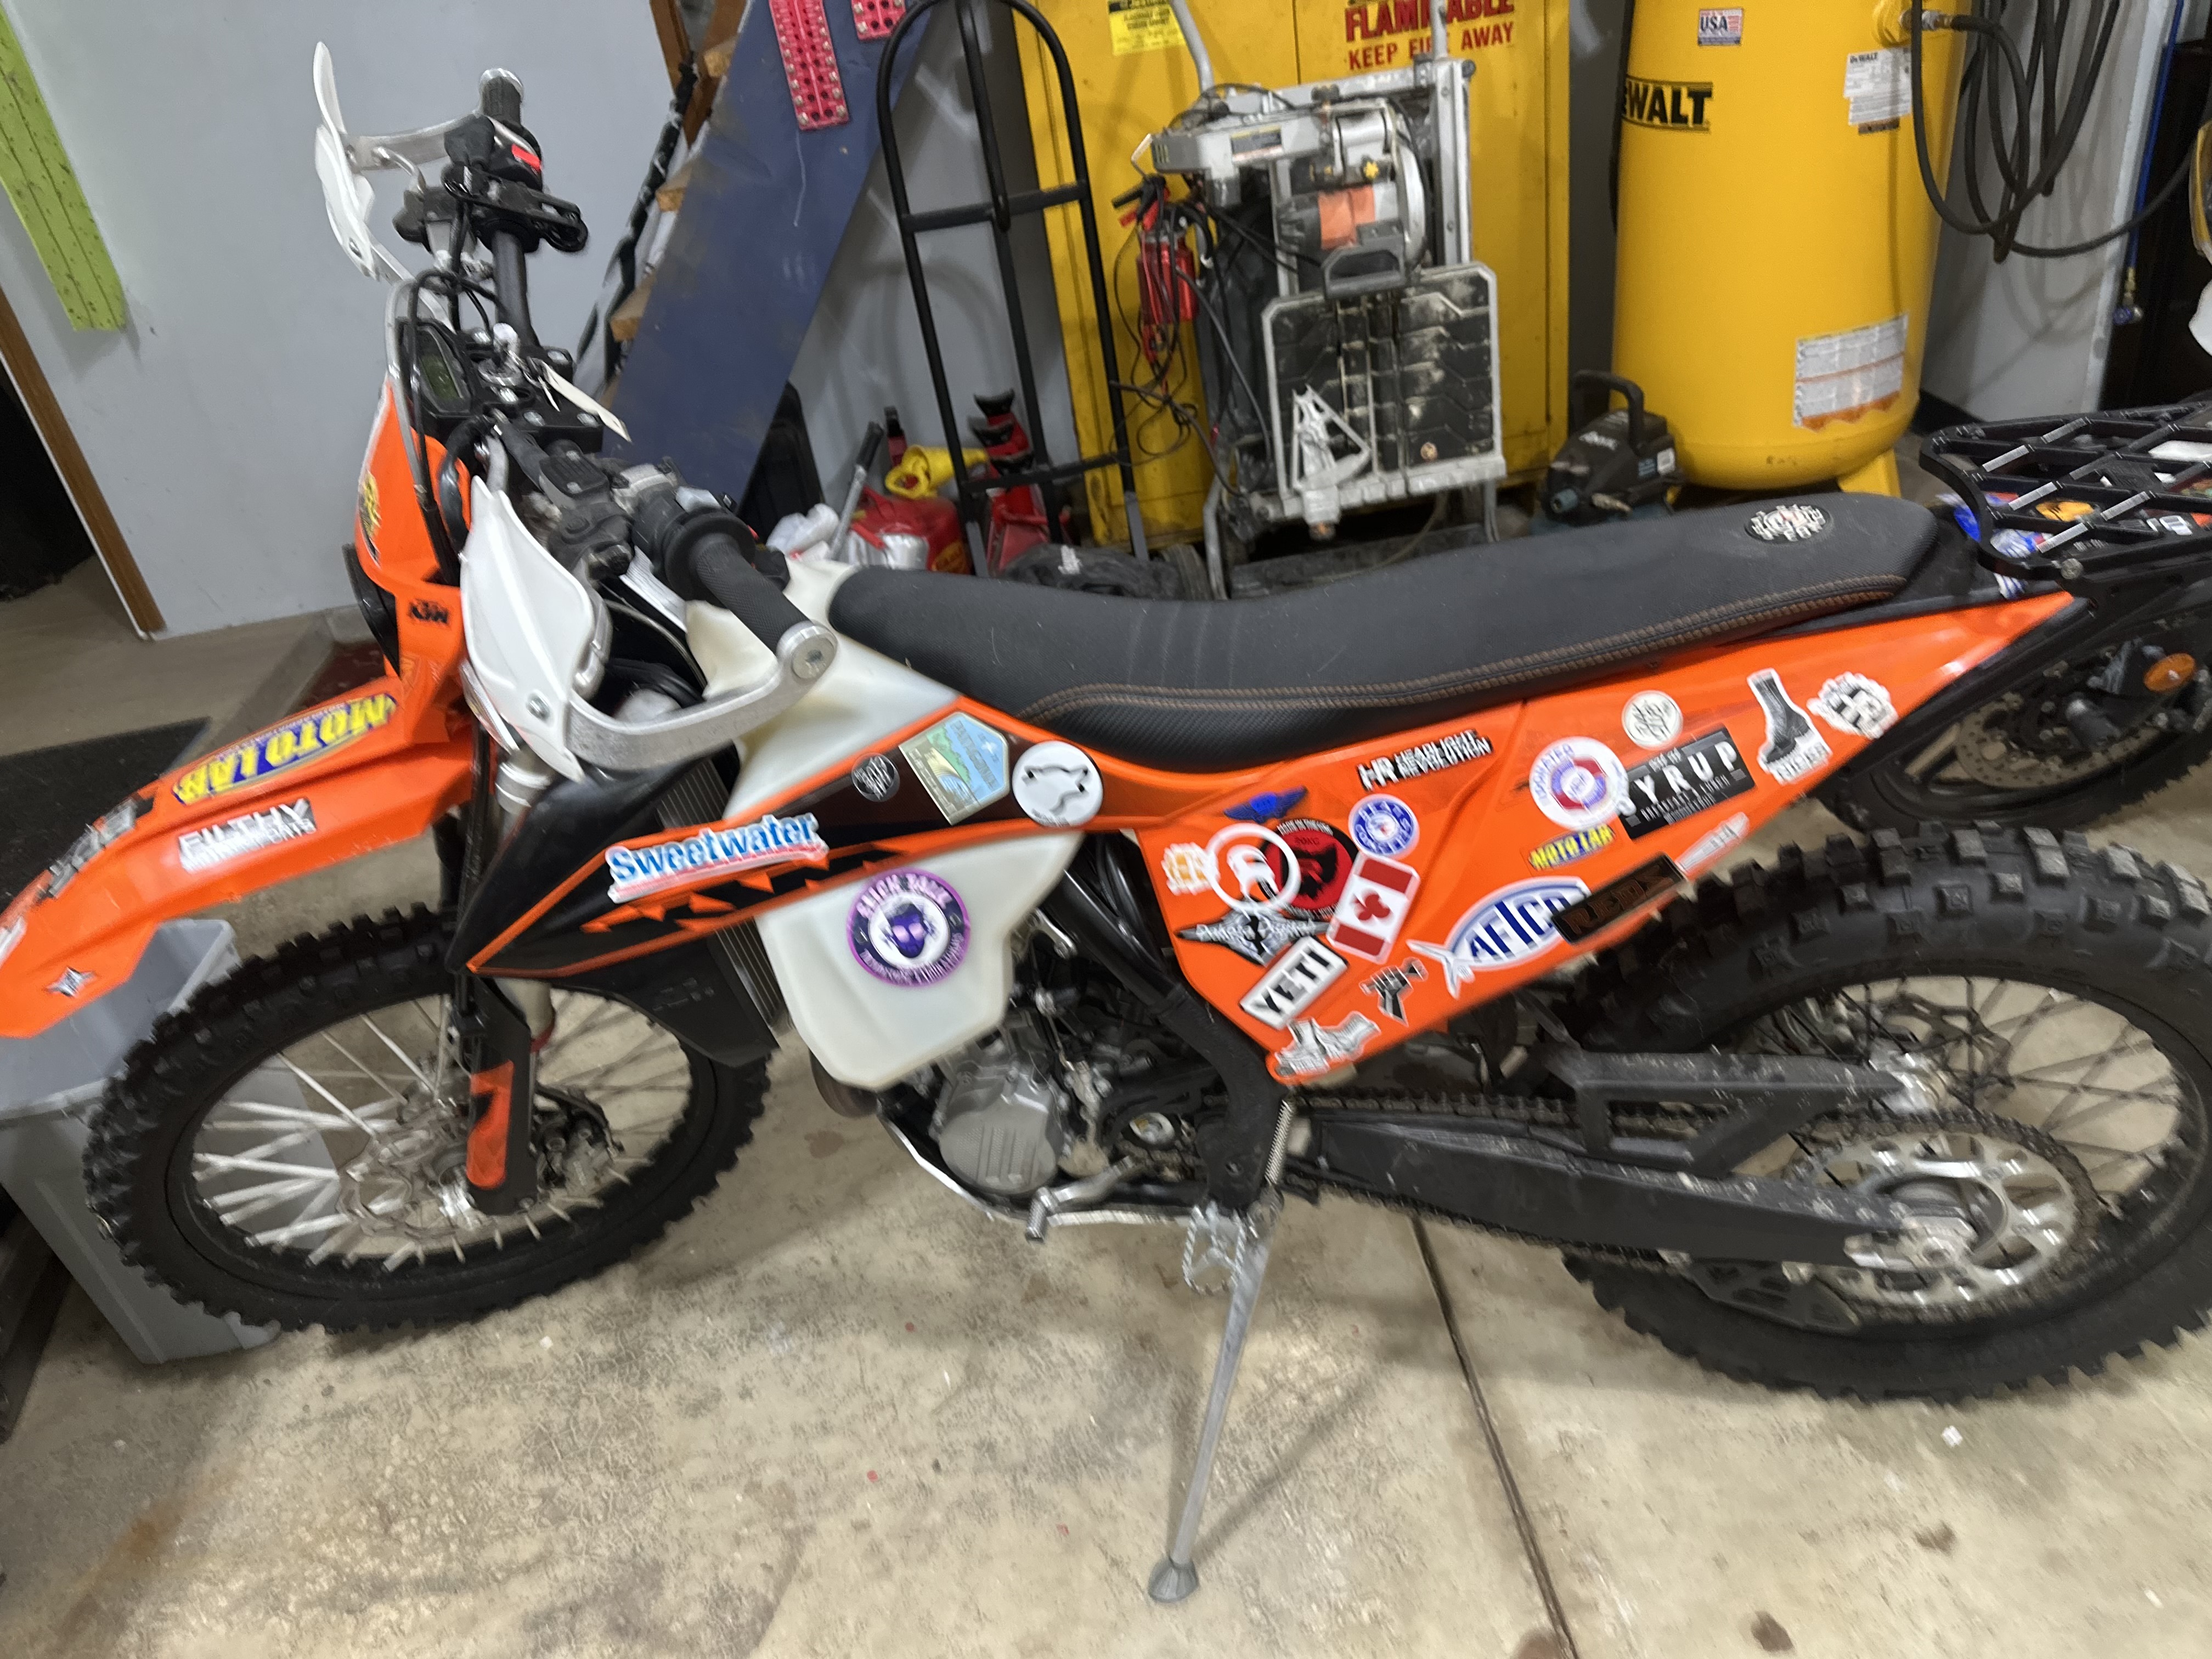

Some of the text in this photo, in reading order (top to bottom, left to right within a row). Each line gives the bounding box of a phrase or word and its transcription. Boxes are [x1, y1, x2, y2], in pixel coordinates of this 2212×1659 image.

[1348, 42, 1398, 70] KEEP
[1461, 21, 1514, 50] AWAY
[1700, 15, 1728, 31] USA
[266, 693, 396, 769] MOTO
[611, 816, 816, 881] Sweetwater
[1528, 836, 1581, 871] MOTO
[1254, 947, 1331, 1014] YETI
